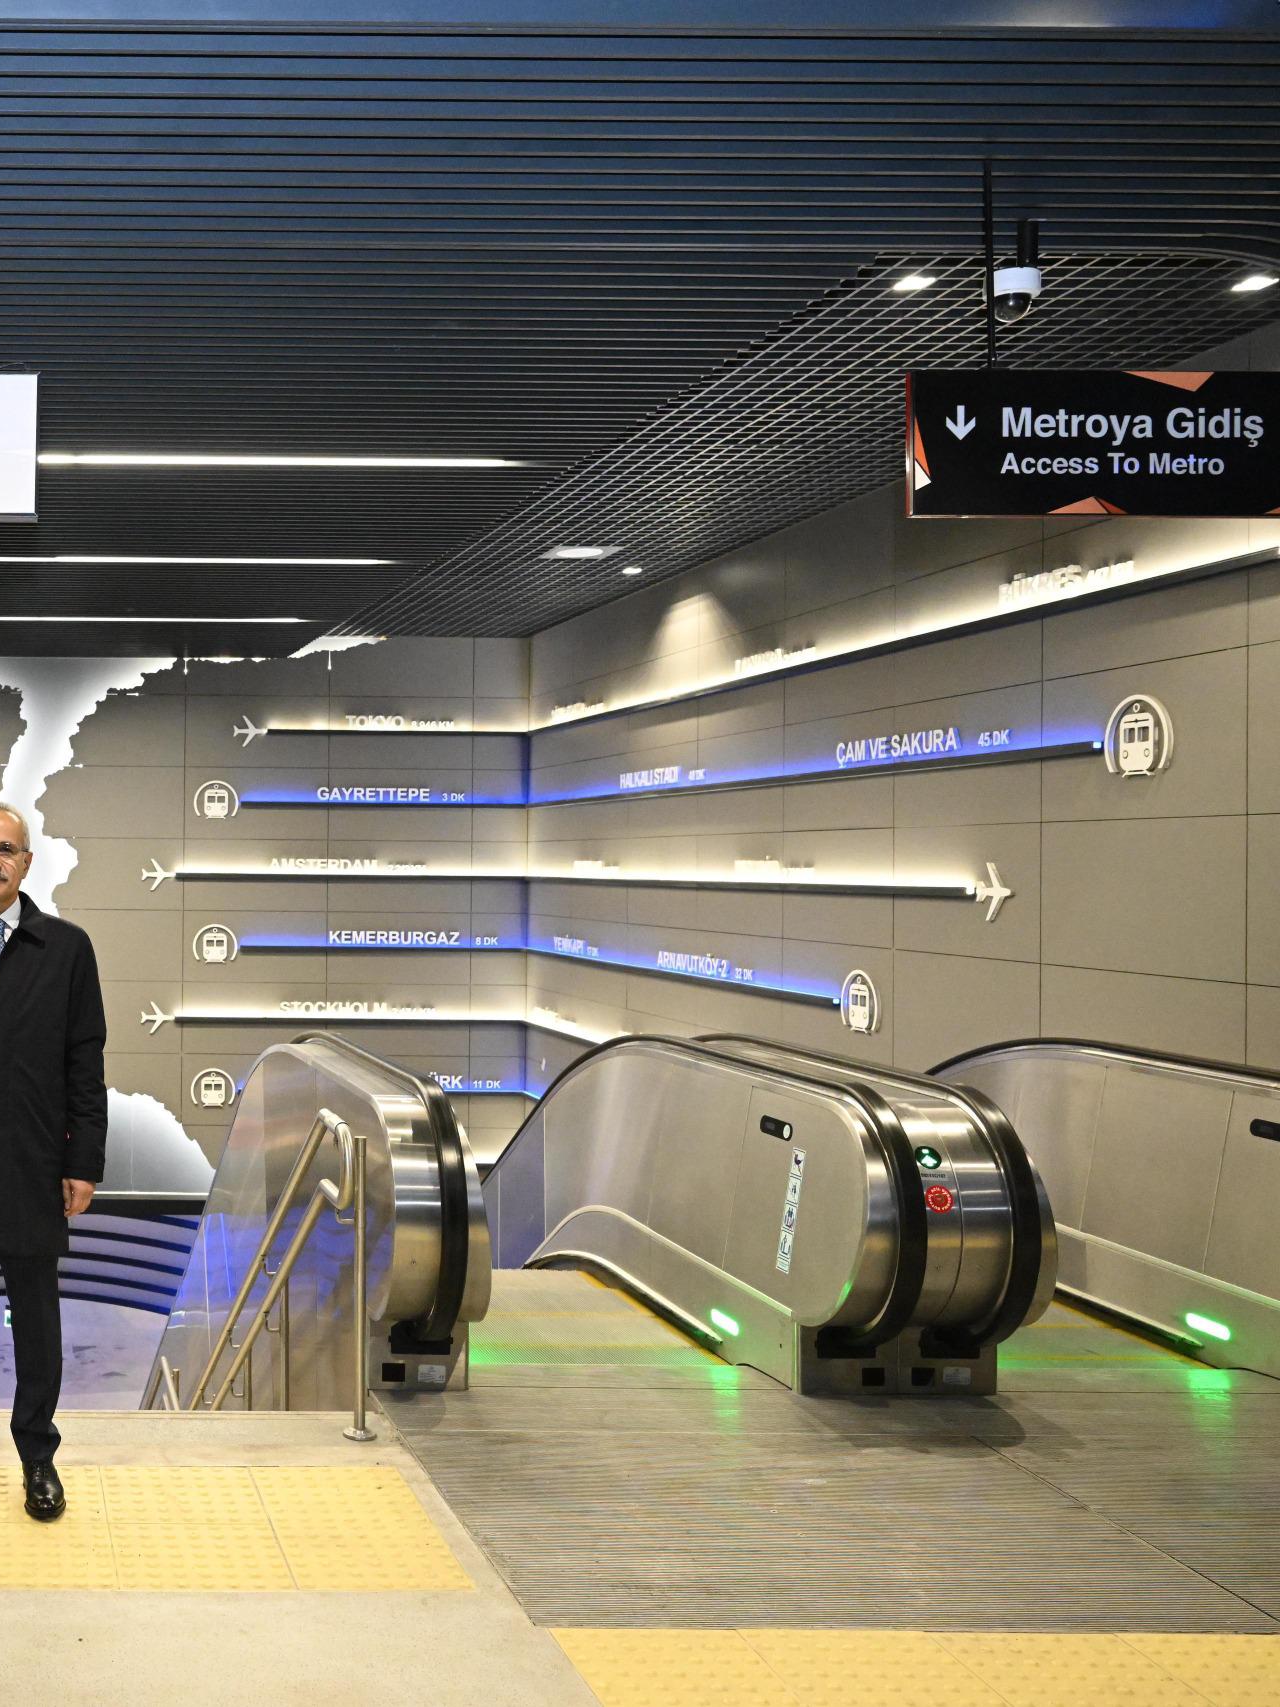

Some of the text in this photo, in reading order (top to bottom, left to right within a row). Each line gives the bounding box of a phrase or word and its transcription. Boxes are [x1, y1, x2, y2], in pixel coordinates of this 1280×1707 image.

[1001, 406, 1264, 448] Metroya Gidiş
[1000, 453, 1225, 475] Access To Metro
[345, 715, 405, 730] TOKYO
[836, 728, 1009, 768] ÇAM VE SAKURA 45 DK
[317, 786, 465, 802] GAYRETTEPE 3 DK
[269, 858, 378, 874] AMSTERDAM
[328, 930, 498, 946] KEMERBURGAZ 8 DK
[279, 1001, 387, 1017] STOCKHOLM
[473, 1080, 482, 1089] 11
[486, 1080, 501, 1089] DK
